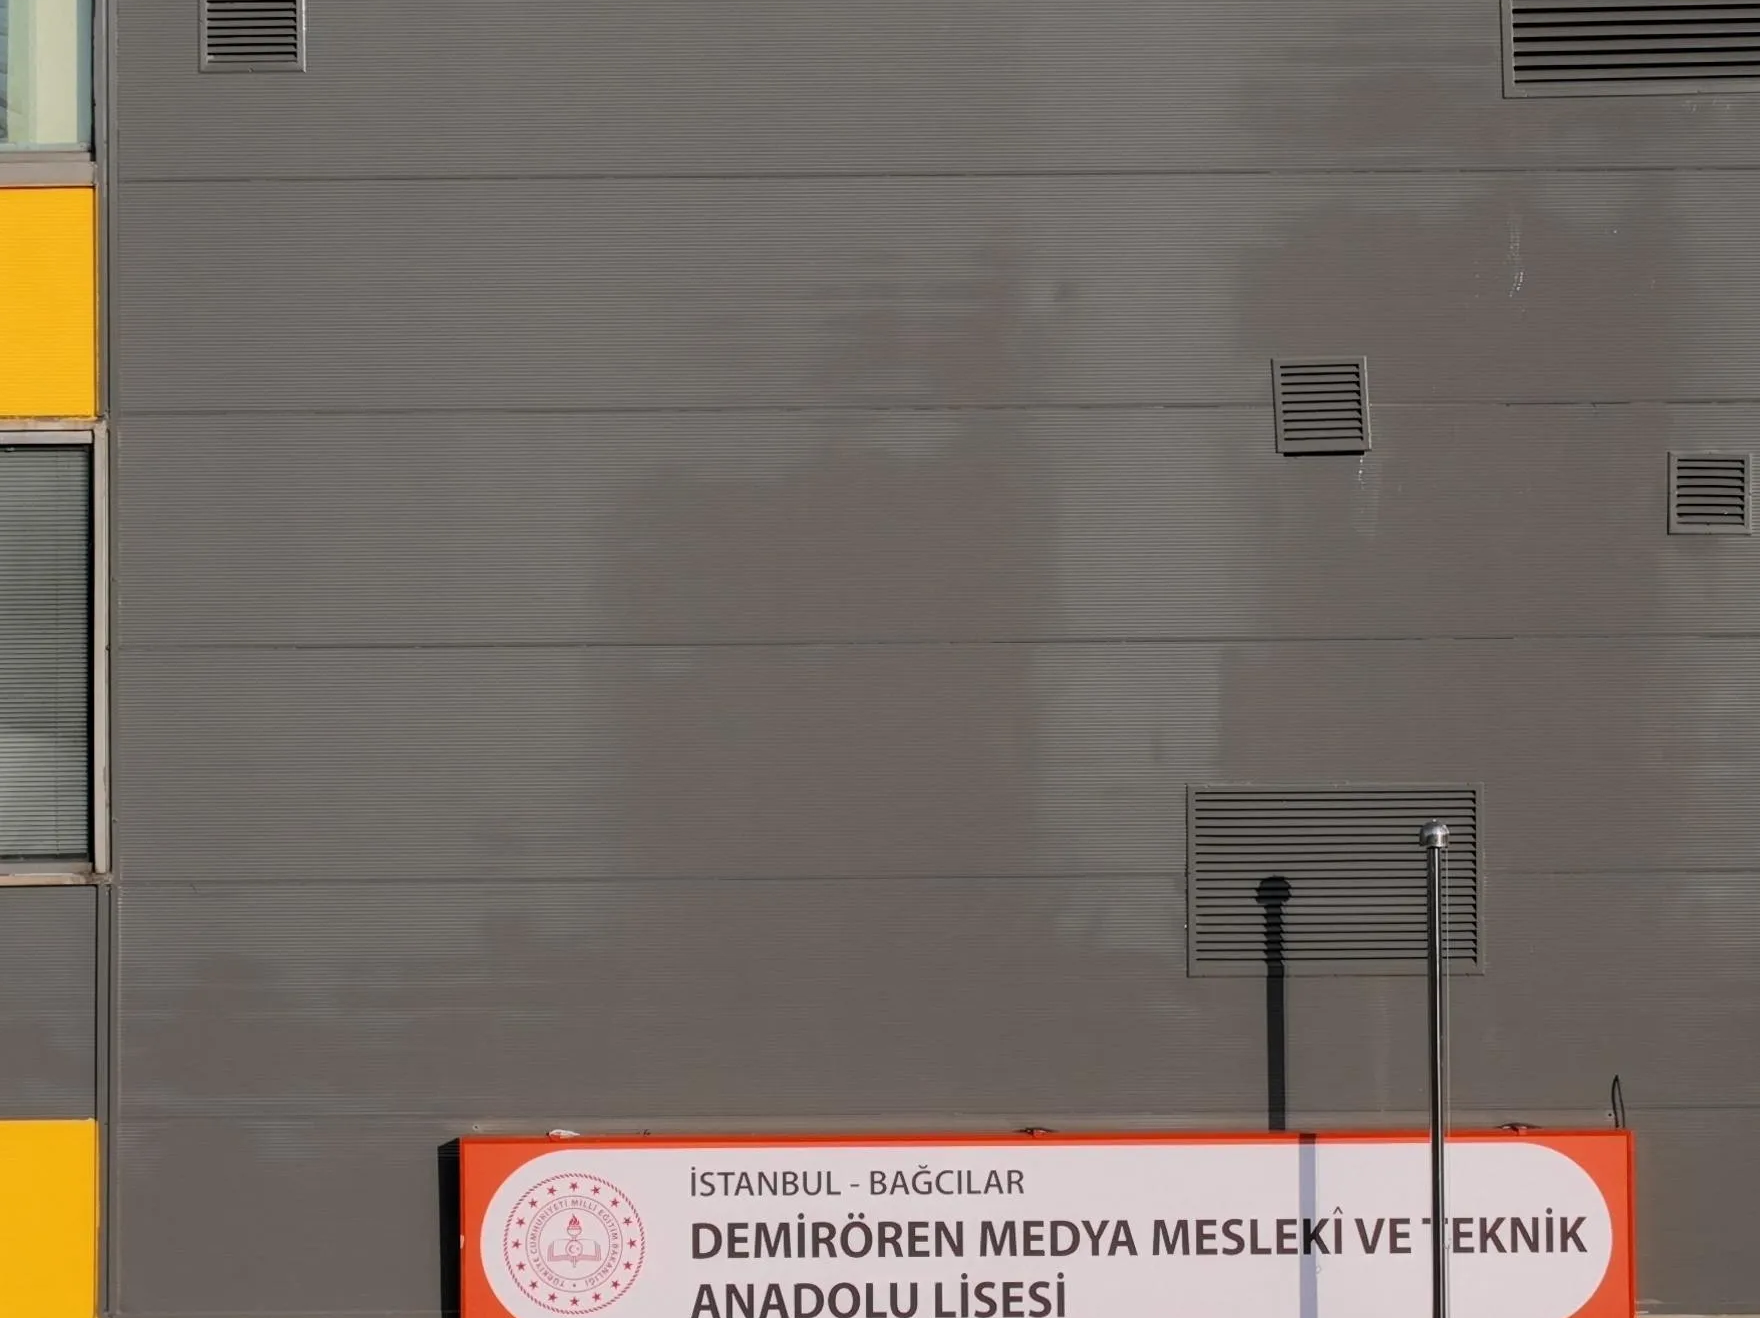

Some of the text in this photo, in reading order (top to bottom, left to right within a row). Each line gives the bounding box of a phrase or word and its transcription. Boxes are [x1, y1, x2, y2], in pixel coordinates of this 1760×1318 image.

[690, 1166, 841, 1196] İSTANBUL
[870, 1164, 1025, 1195] BAĞCILAR
[691, 1206, 1588, 1259] DEMİRÖREN MEDYA MESLEKÎ VE EKNİK
[934, 1272, 1065, 1318] LİSESİ
